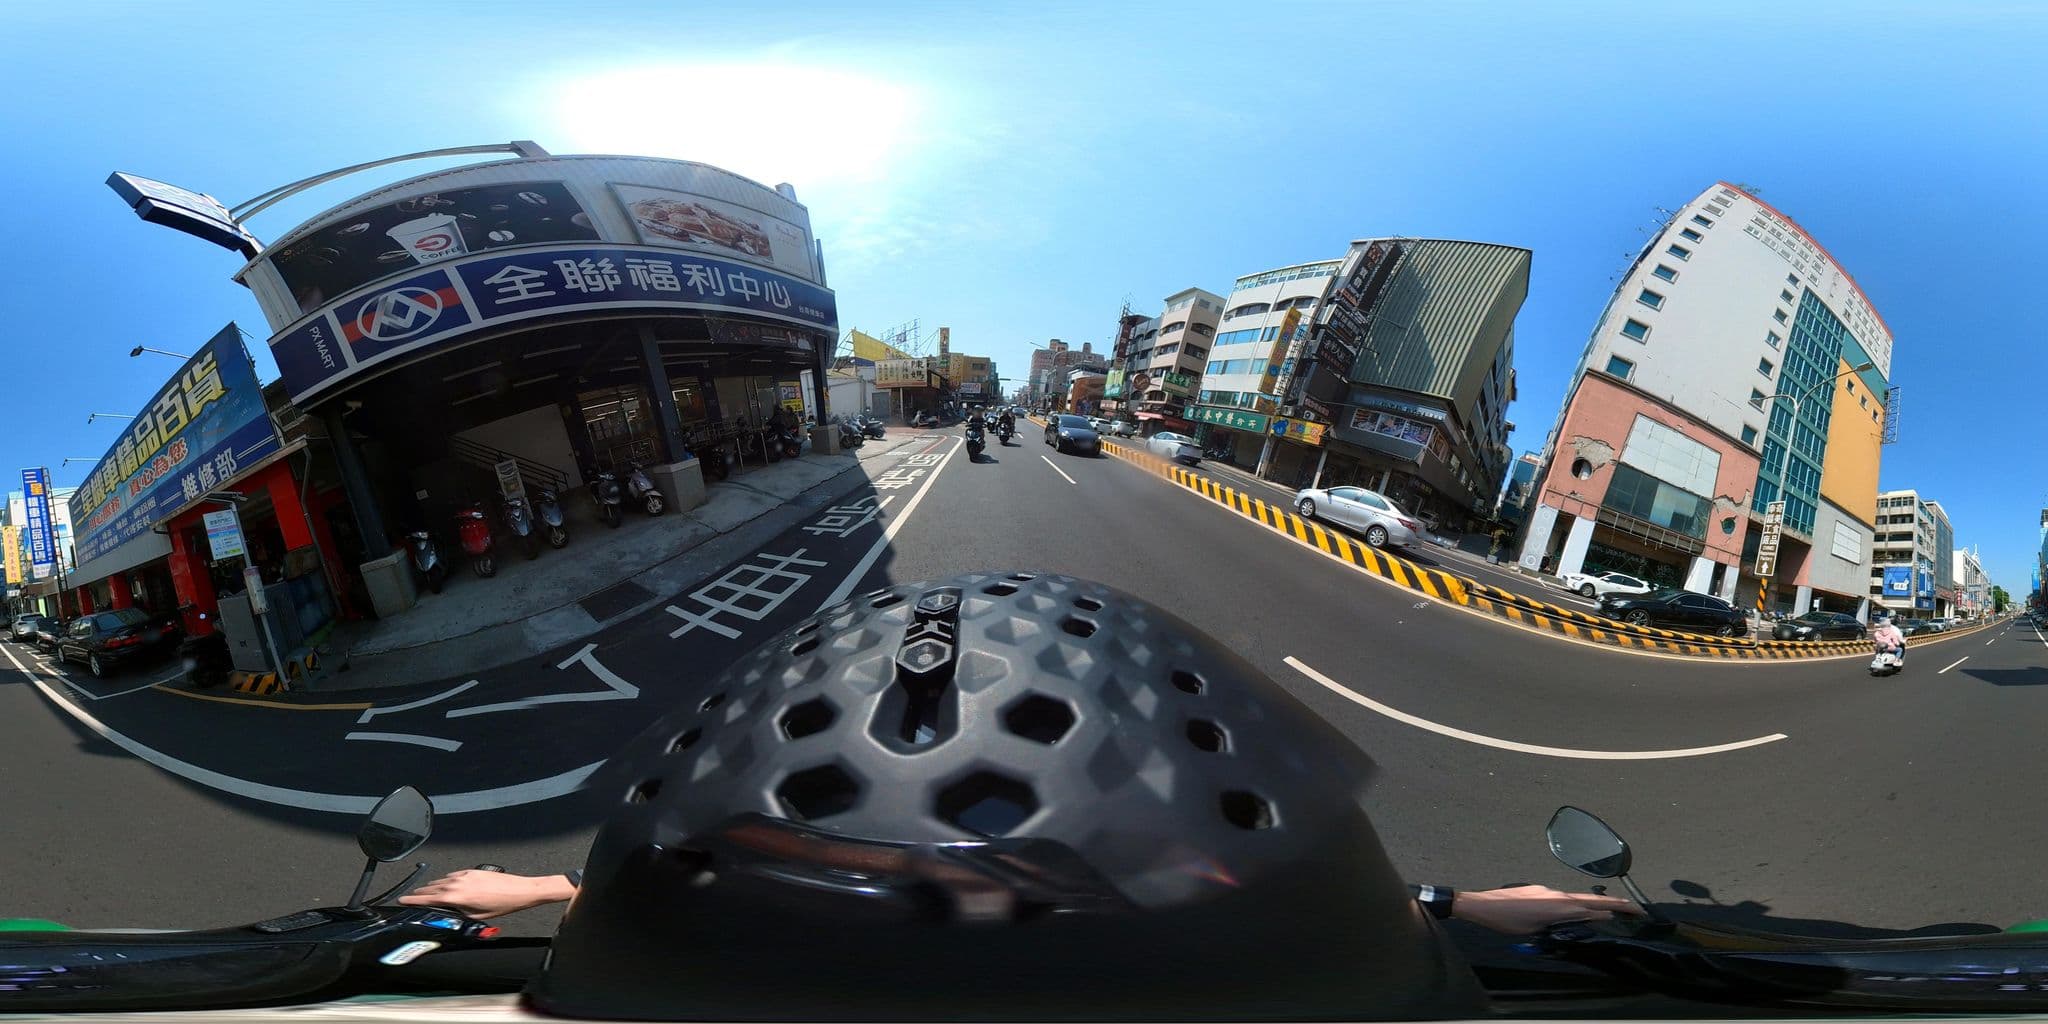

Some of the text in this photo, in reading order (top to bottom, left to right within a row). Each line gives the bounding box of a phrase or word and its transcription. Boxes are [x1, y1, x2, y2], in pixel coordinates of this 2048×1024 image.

[483, 257, 793, 309] 全聯福利中心
[72, 350, 226, 526] 三星機車精品百貨
[181, 447, 238, 501] 維修部
